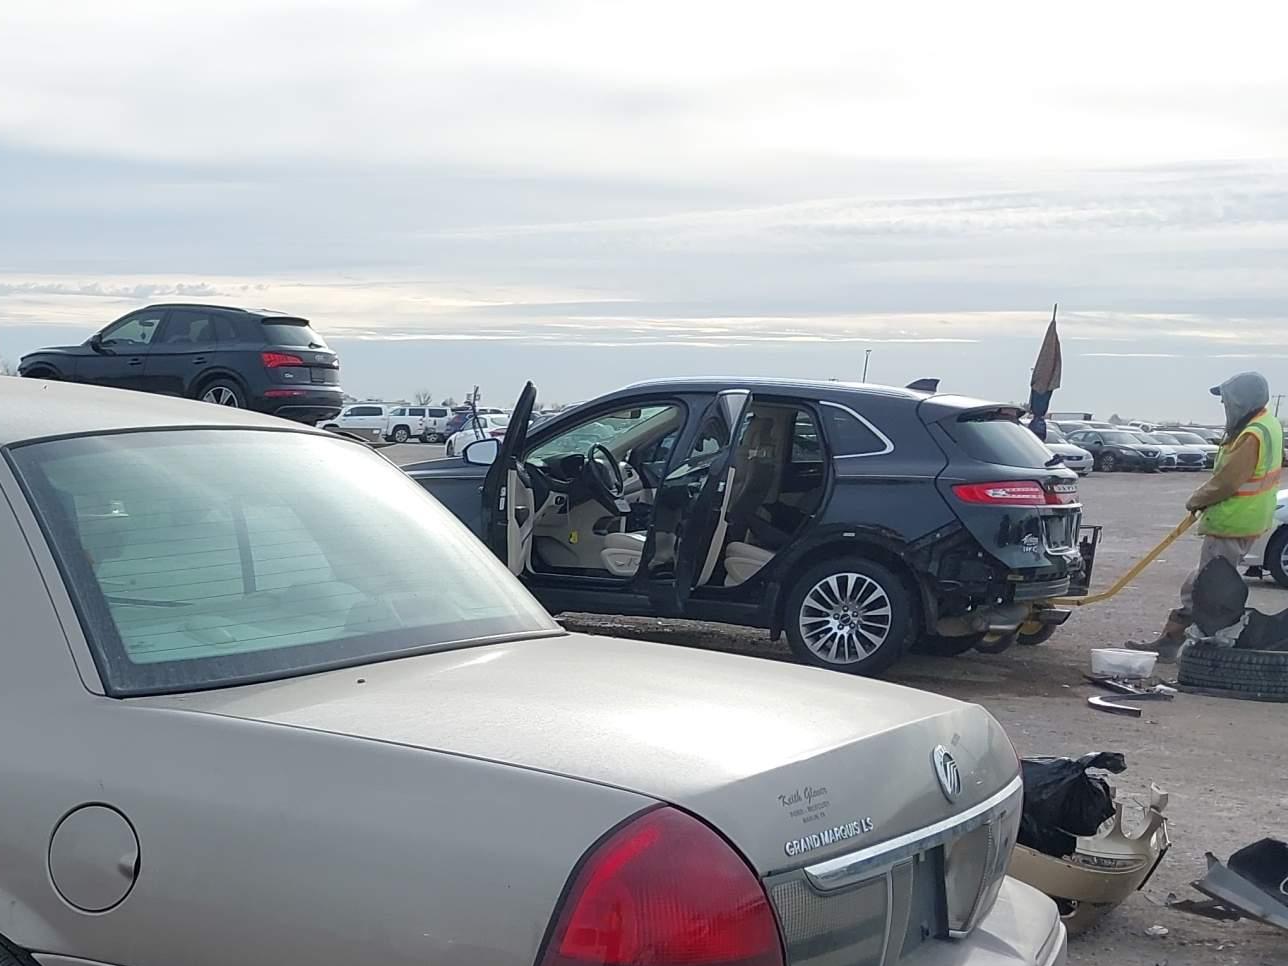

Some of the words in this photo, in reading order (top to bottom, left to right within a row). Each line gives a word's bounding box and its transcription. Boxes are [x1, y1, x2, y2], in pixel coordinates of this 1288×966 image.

[784, 834, 821, 857] GRAND
[819, 820, 861, 847] MARQUIS
[860, 817, 874, 833] LS
